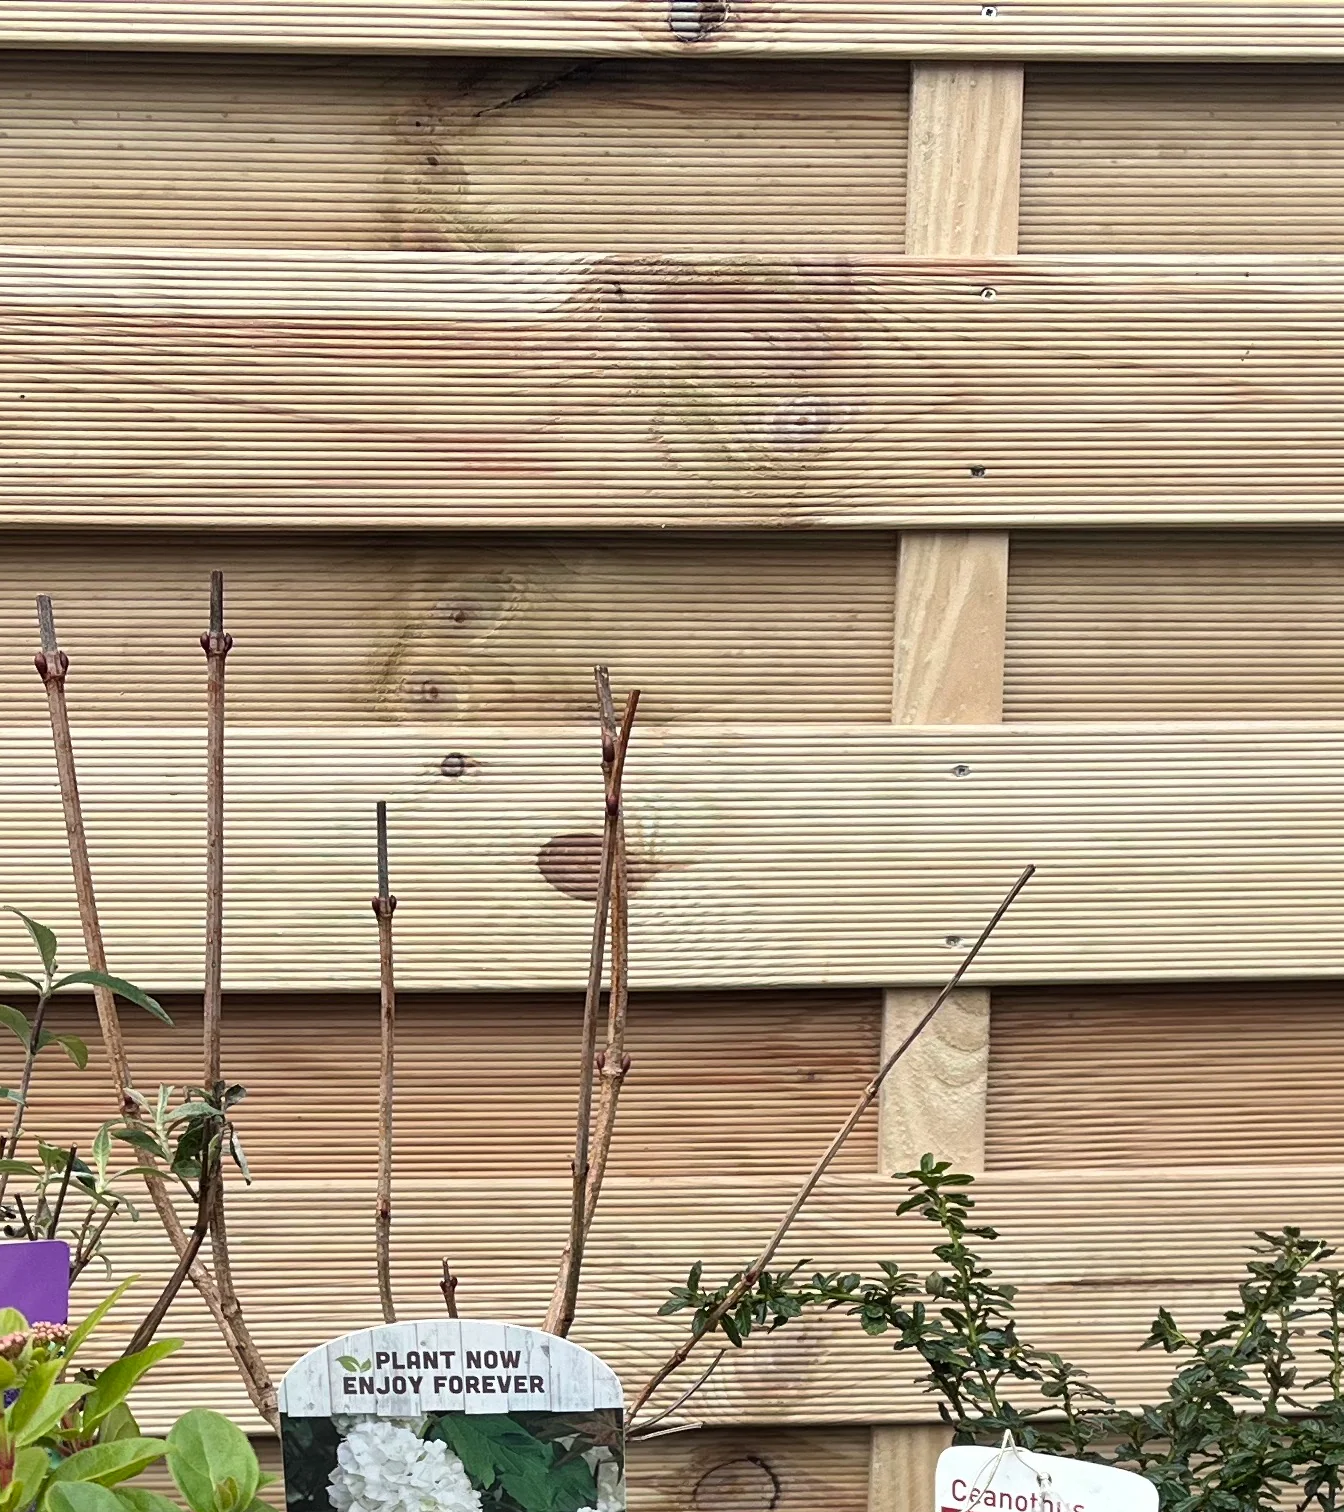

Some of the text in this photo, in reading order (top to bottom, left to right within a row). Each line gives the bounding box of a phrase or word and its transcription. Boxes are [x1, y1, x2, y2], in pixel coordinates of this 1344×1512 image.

[376, 1351, 521, 1370] PLANT NOW
[343, 1376, 545, 1395] ENJOY FOREVER
